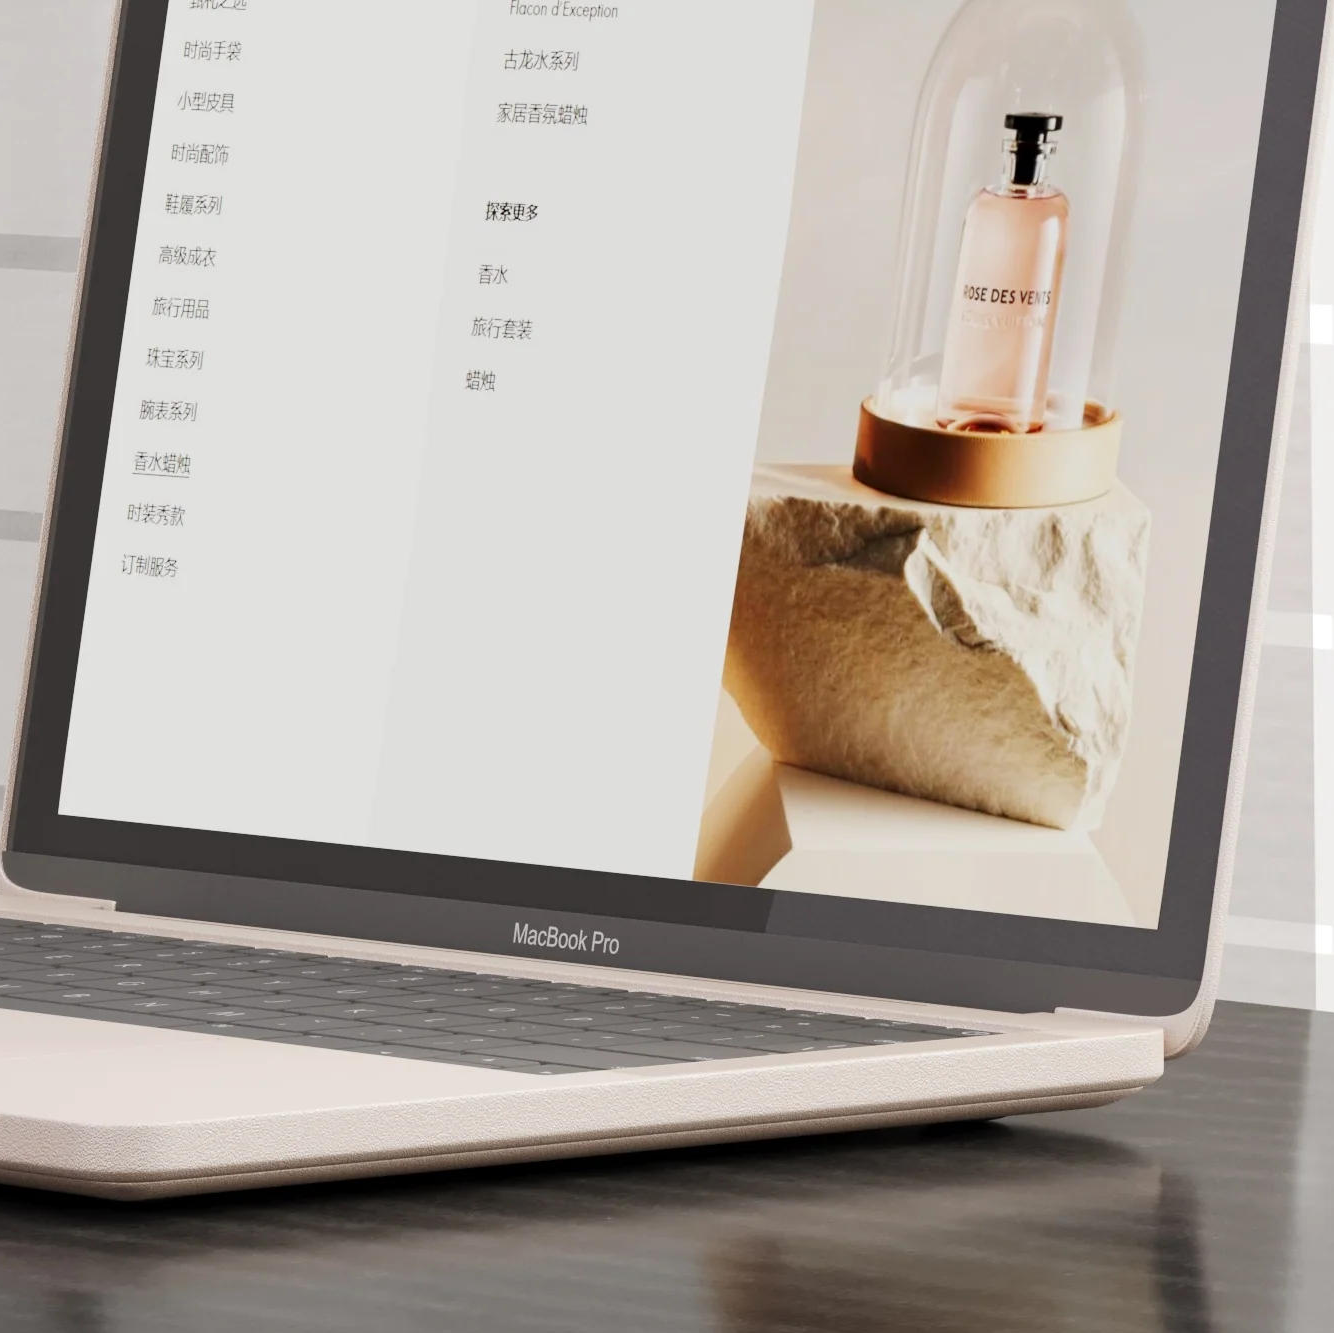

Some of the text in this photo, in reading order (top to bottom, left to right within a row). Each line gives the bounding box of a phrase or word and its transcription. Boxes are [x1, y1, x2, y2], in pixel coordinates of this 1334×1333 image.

[550, 1, 619, 21] d'Exception
[183, 40, 242, 62] 时尚手袋
[503, 49, 579, 73] 古龙水系列
[177, 92, 235, 114] 小型皮具
[496, 102, 588, 127] 家居香氛蜡烛
[171, 144, 230, 166] 时尚配饰
[164, 193, 223, 216] 鞋履系列
[485, 201, 539, 223] 探索更多
[158, 245, 217, 268] 高级成衣
[478, 264, 509, 286] 香水
[963, 285, 1051, 306] ROSE DES VENTS
[152, 297, 210, 320] 旅行用品
[471, 317, 533, 341] 旅行套装
[146, 348, 204, 371] 珠宝系列
[465, 370, 496, 393] 蜡烛
[139, 400, 197, 423] 腕表系列
[133, 452, 191, 475] 香水蜡烛
[127, 503, 185, 527] 时装秀款
[121, 555, 179, 578] 订制服务
[512, 922, 620, 955] MacBook Pro
